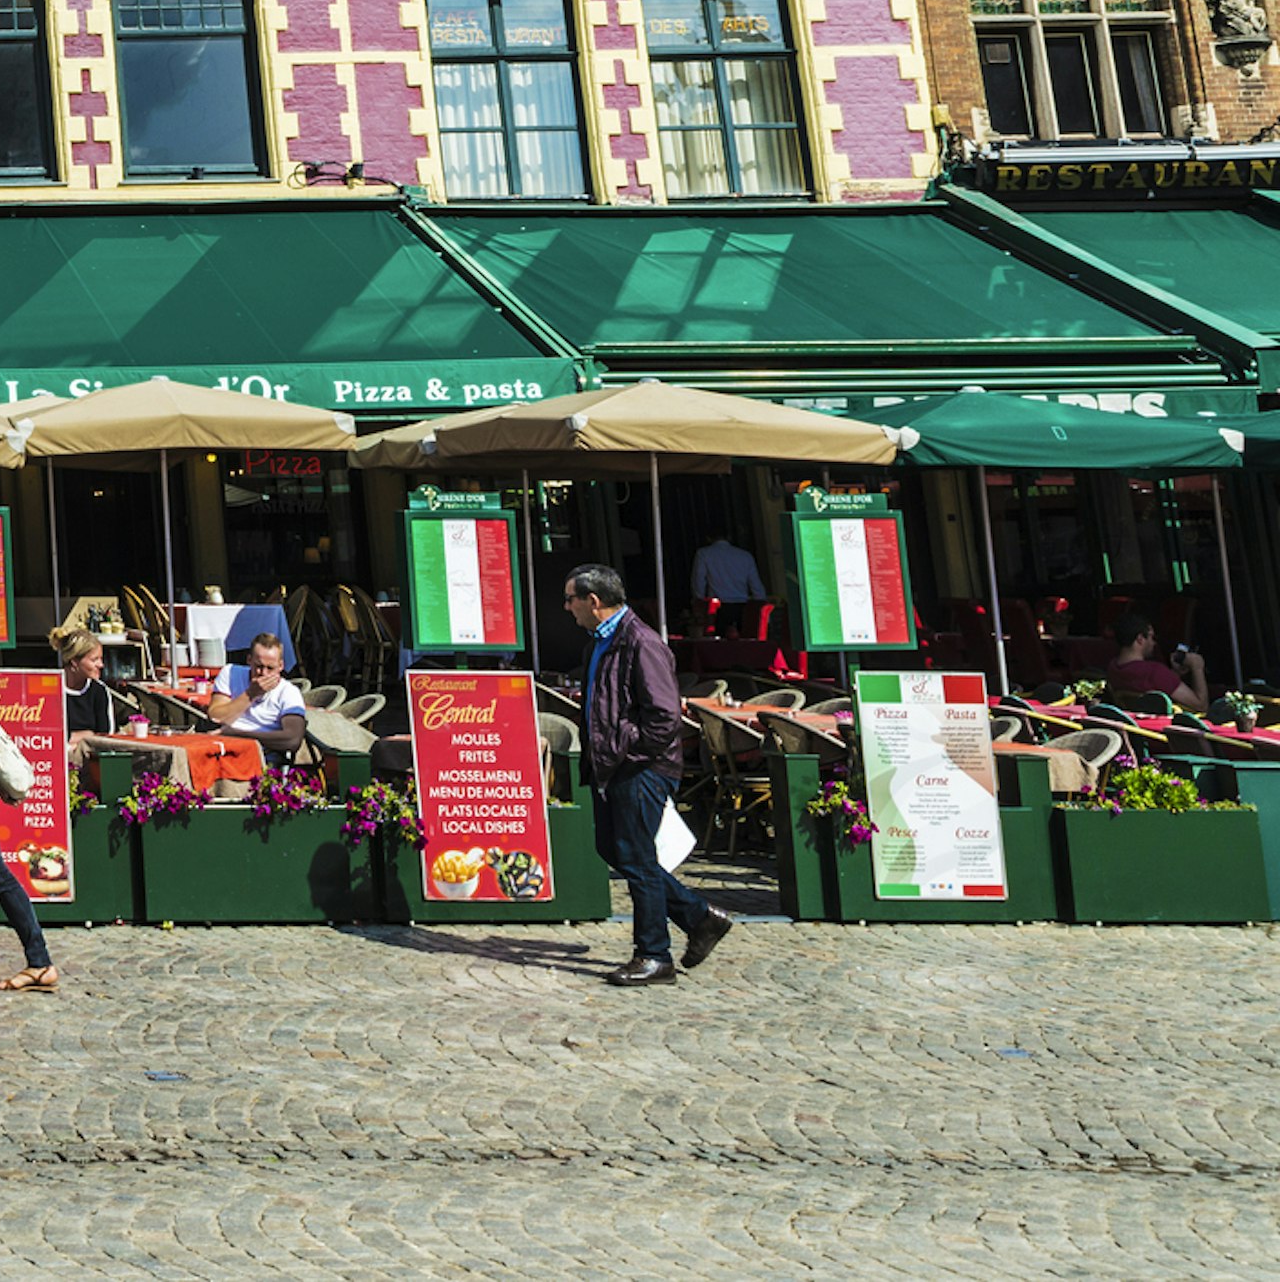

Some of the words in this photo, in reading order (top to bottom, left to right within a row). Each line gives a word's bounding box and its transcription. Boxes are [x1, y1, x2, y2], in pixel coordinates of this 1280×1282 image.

[333, 380, 413, 403] Pizza
[425, 378, 451, 402] &
[462, 379, 543, 406] pasta
[245, 449, 321, 475] Pizza
[411, 675, 477, 691] Restaurant
[418, 692, 497, 730] Central
[874, 708, 908, 719] Pizza
[944, 708, 976, 719] Pasta
[14, 735, 53, 750] NCH
[451, 733, 501, 745] MOULES
[458, 750, 496, 763] FRITES
[438, 770, 522, 783] MOSSELMENU
[915, 774, 949, 787] Carne
[429, 786, 465, 799] MENU
[467, 787, 482, 798] DE
[484, 786, 534, 799] MOULES
[23, 804, 54, 814] PASTA
[438, 805, 472, 817] PLATS
[474, 805, 527, 817] LOCALES
[24, 816, 54, 827] PIZZA
[443, 821, 483, 833] LOCAL
[485, 821, 525, 834] DISHES
[887, 826, 918, 838] Pesce
[955, 827, 989, 839] Cozze
